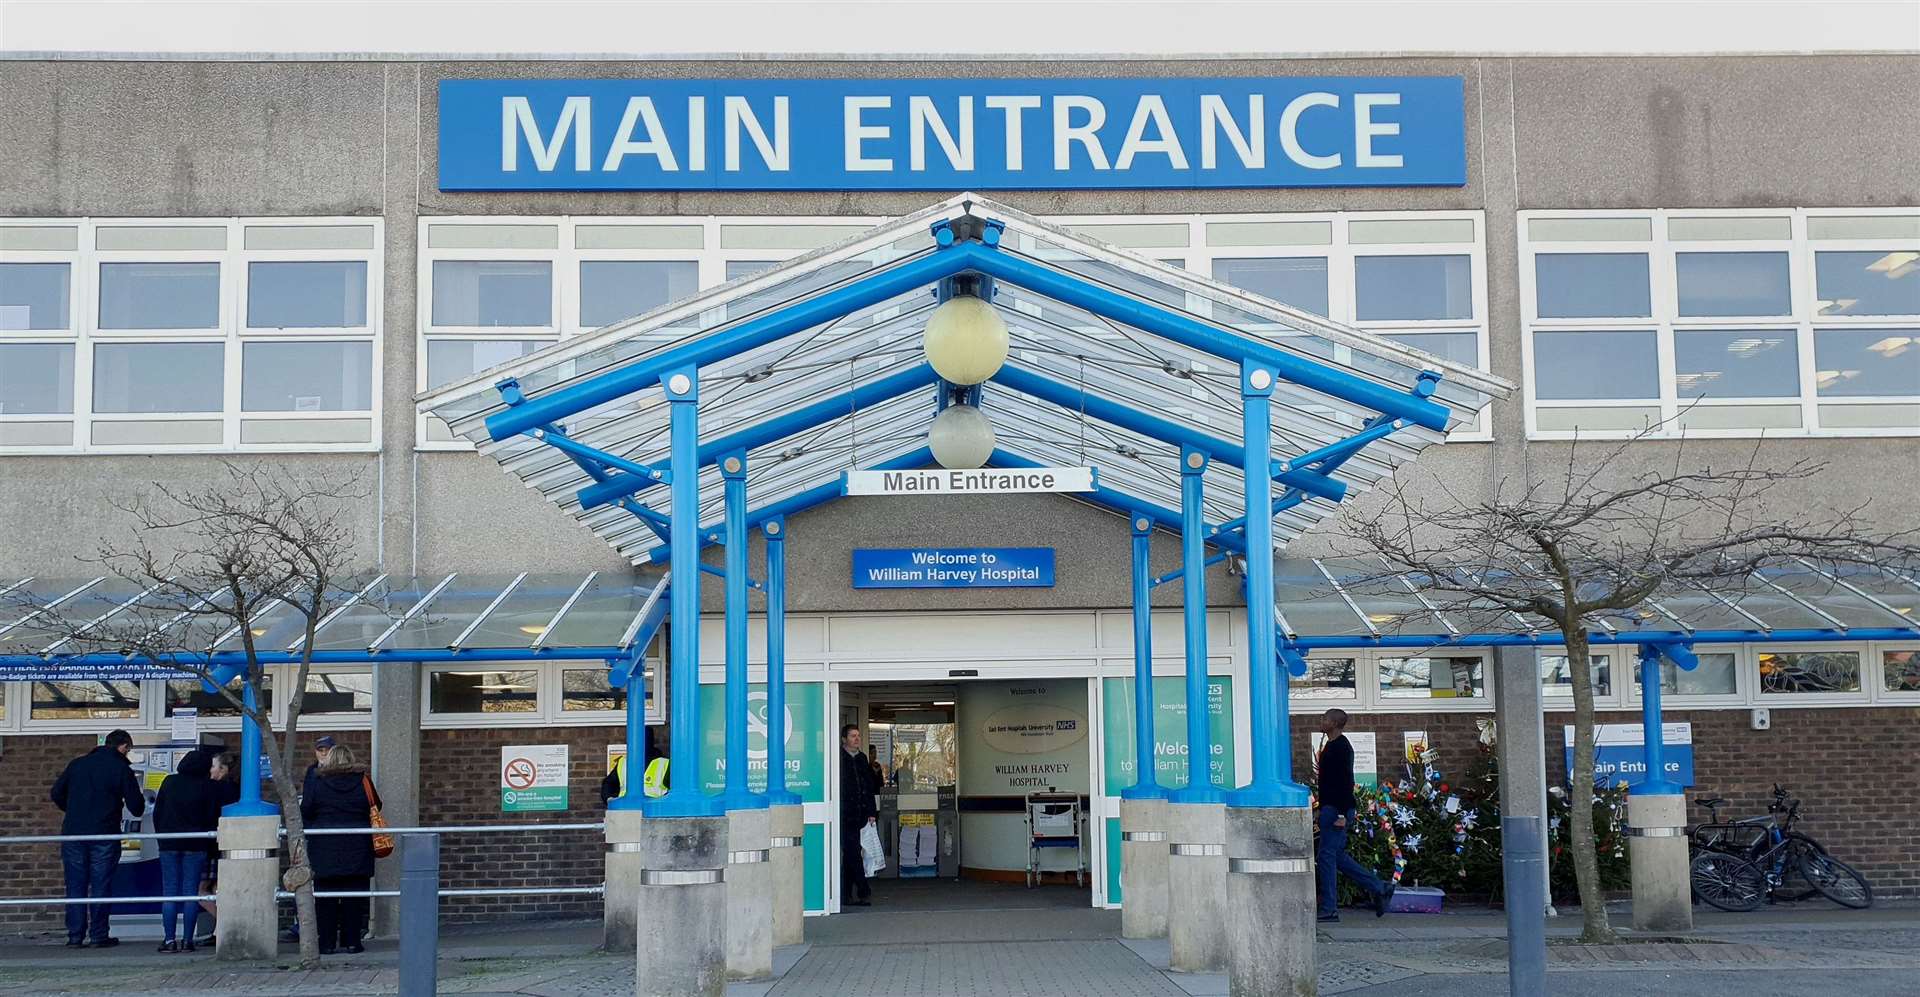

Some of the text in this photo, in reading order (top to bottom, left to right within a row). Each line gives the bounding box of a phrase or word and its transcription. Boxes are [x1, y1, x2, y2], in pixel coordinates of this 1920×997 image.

[502, 92, 1404, 172] MAIN ENTRANCE
[884, 472, 1055, 491] Main Entrance
[912, 552, 996, 565] Welcome to
[869, 566, 1039, 583] William Harvey Hospital
[1057, 720, 1076, 730] NHS
[994, 763, 1070, 775] WILLIAM HARVEY
[1121, 761, 1133, 772] to
[1595, 760, 1616, 773] ain
[1009, 777, 1050, 787] HOSPITAL
